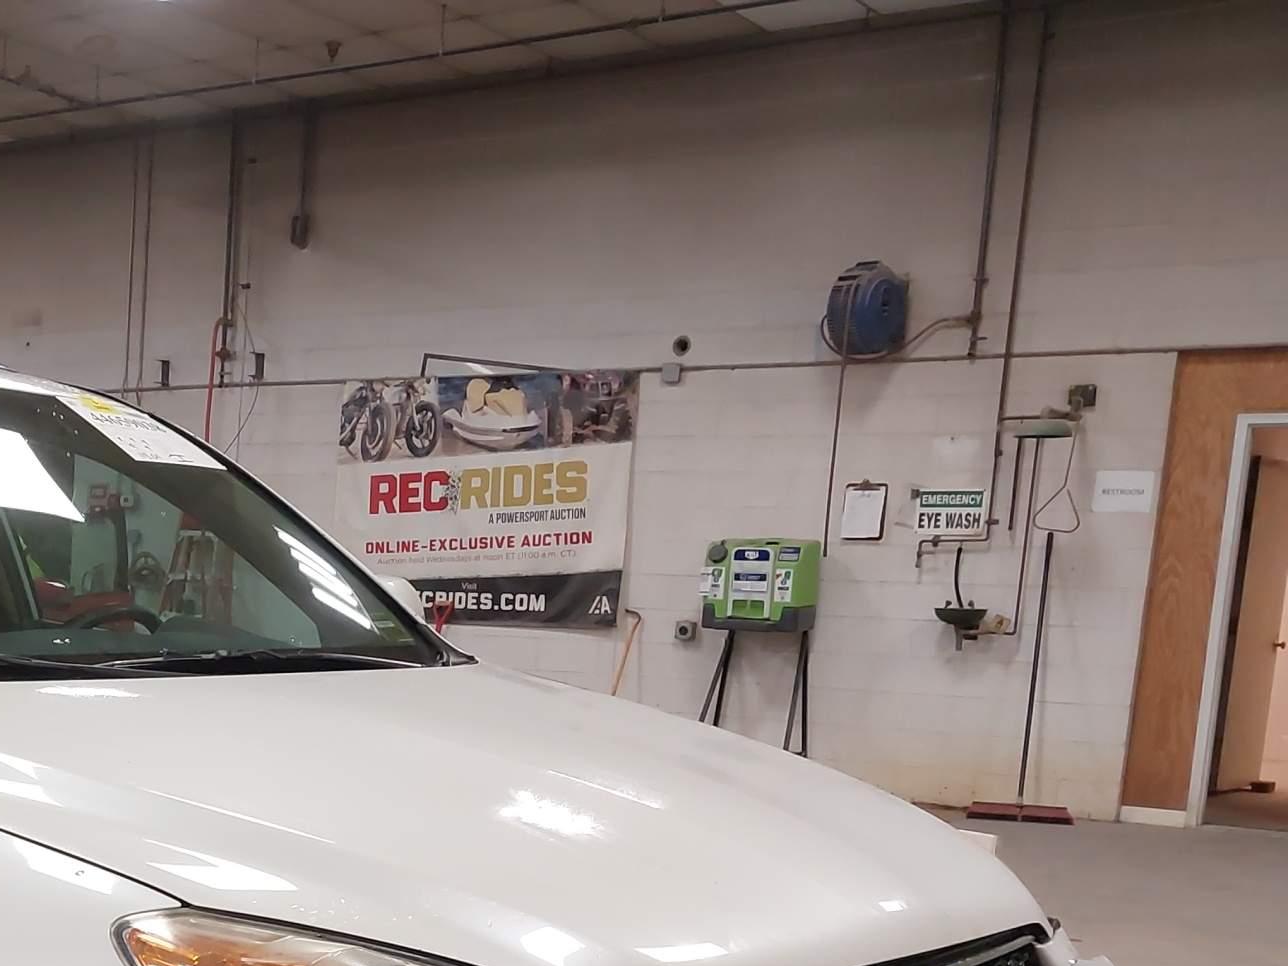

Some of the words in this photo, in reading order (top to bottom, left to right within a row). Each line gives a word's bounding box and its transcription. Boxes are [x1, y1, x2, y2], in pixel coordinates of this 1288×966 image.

[369, 470, 451, 514] REC
[460, 461, 588, 510] RIDES
[921, 494, 982, 505] EMERGENCY
[489, 513, 494, 524] A
[496, 510, 549, 524] POWERSPORT
[550, 507, 586, 521] AUCTION
[917, 512, 942, 529] EYE
[945, 511, 981, 529] WASH
[365, 535, 515, 554] ONLINE-EXCLUSIVE
[520, 531, 592, 548] AUCTION
